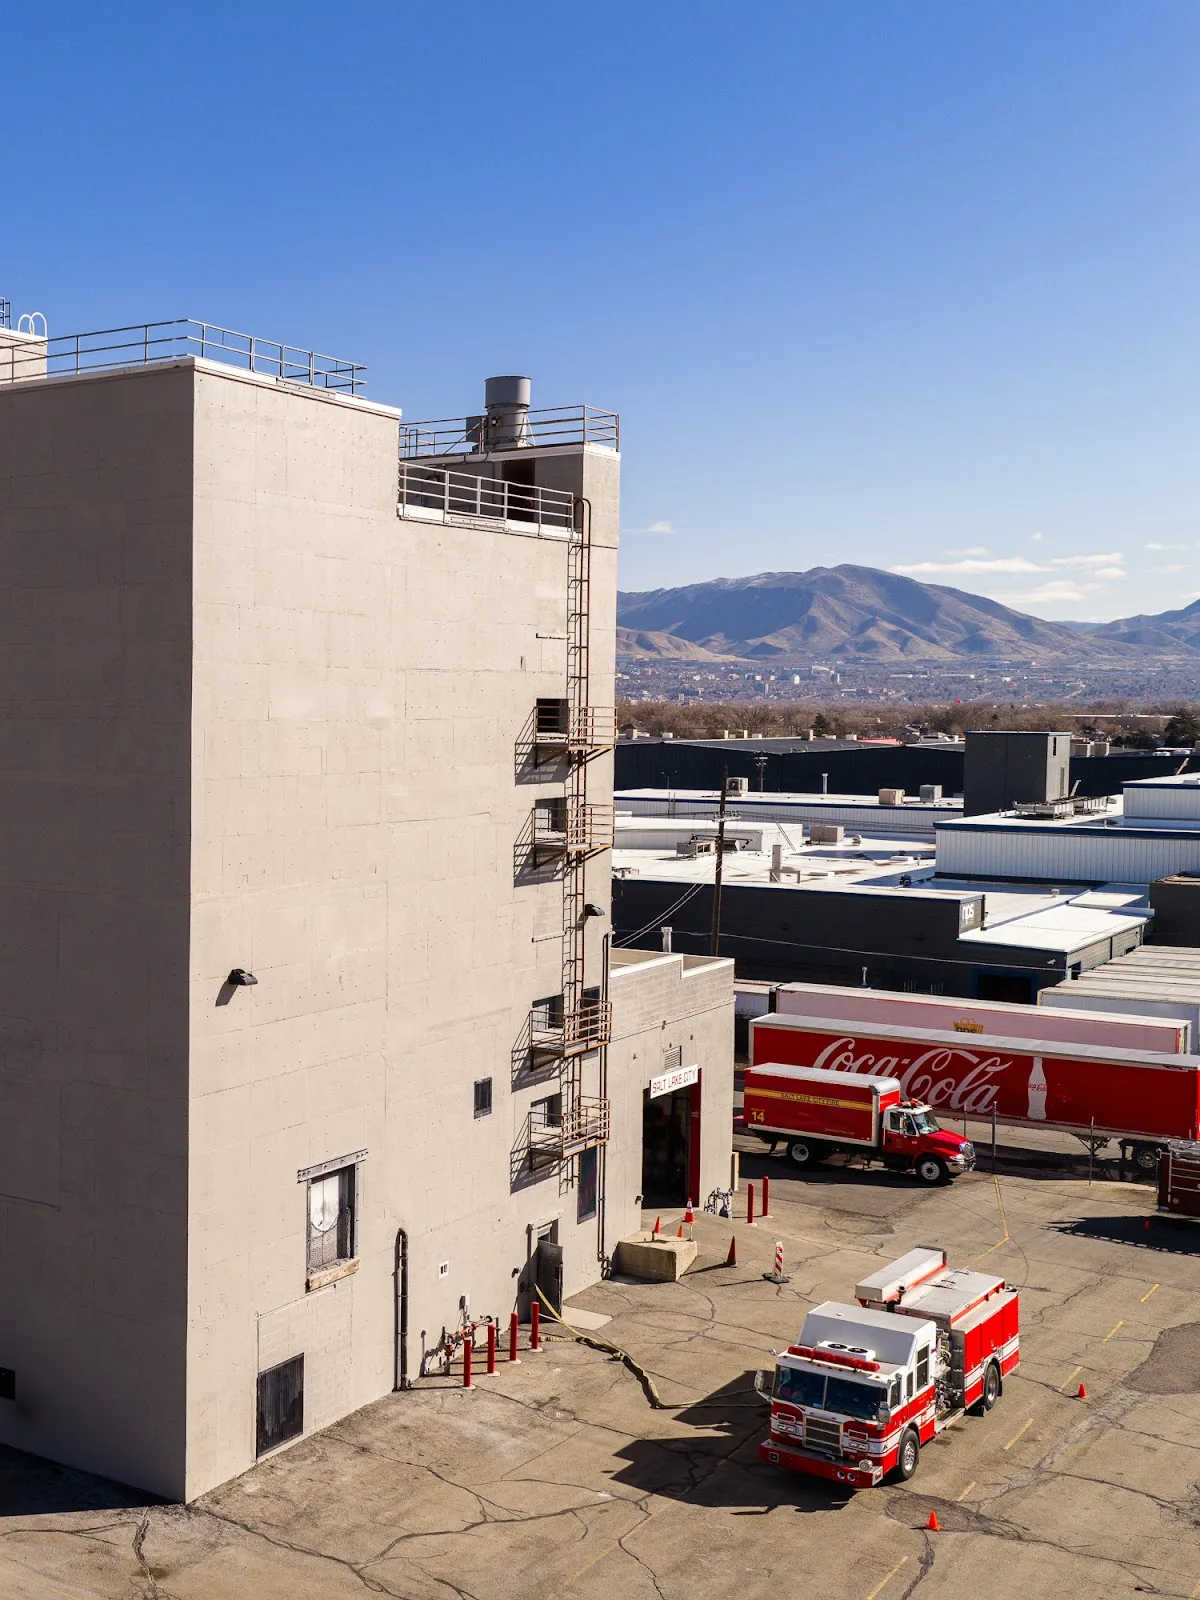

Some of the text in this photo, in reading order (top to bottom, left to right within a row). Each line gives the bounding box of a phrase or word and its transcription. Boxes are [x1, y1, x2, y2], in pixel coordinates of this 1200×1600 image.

[652, 1069, 697, 1094] SALT LAKE CITY
[812, 1037, 1014, 1115] Coca-Cola
[751, 1111, 765, 1122] 14
